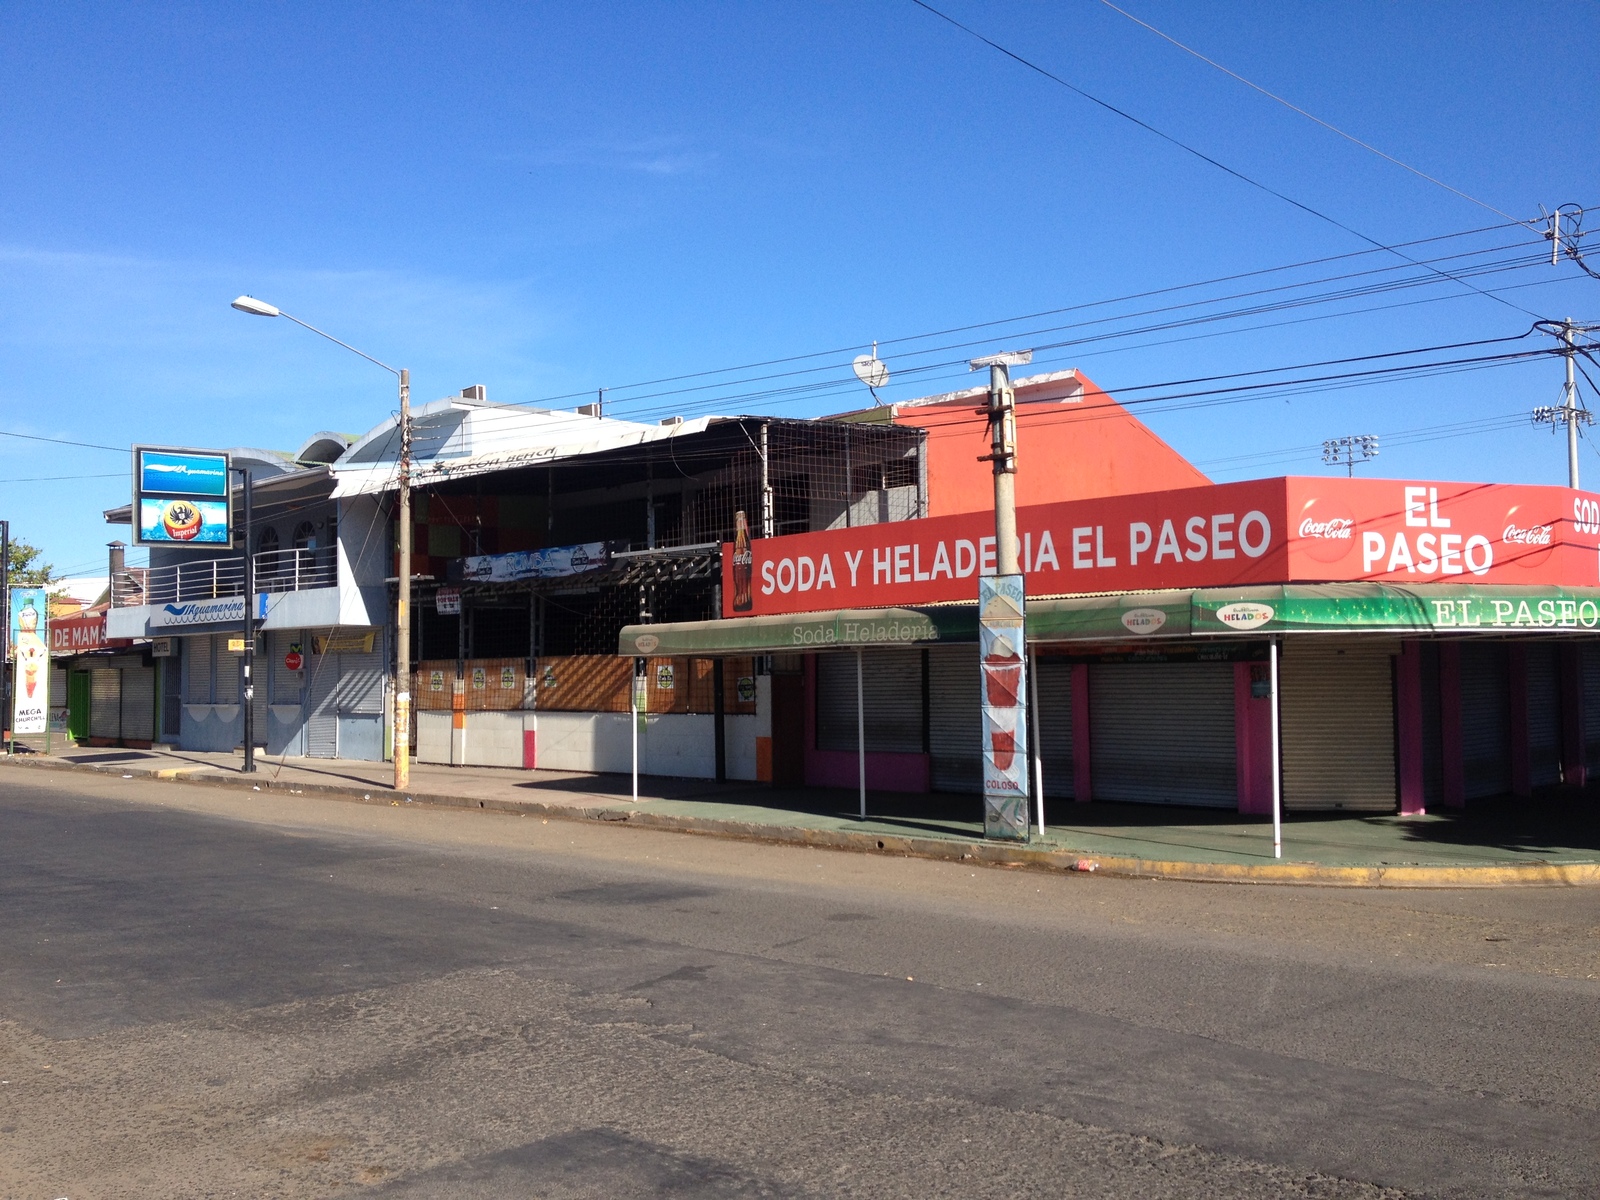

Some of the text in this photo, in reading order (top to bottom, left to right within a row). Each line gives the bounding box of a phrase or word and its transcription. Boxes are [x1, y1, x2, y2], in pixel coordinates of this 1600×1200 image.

[1404, 486, 1450, 528] EL
[1573, 497, 1600, 535] SOD
[172, 525, 198, 539] Imperial
[1299, 517, 1354, 539] Coca-Cola
[1503, 524, 1553, 545] Coca-Cola
[506, 551, 554, 571] RUMBA
[761, 510, 1272, 595] SODA Y HELADEIA EL PASEO
[1362, 531, 1494, 576] PASEO
[995, 583, 1022, 602] PASEO
[188, 599, 244, 620] Aguamarina
[1224, 612, 1269, 621] HELADOS
[1431, 600, 1599, 628] EL PASEO
[1126, 617, 1162, 626] HELADOS
[54, 620, 107, 648] DE MAMÁ
[793, 622, 940, 645] Soda Heladería
[153, 641, 170, 653] HOTEL
[18, 708, 42, 716] MEGA
[986, 780, 1019, 790] COLOSO
